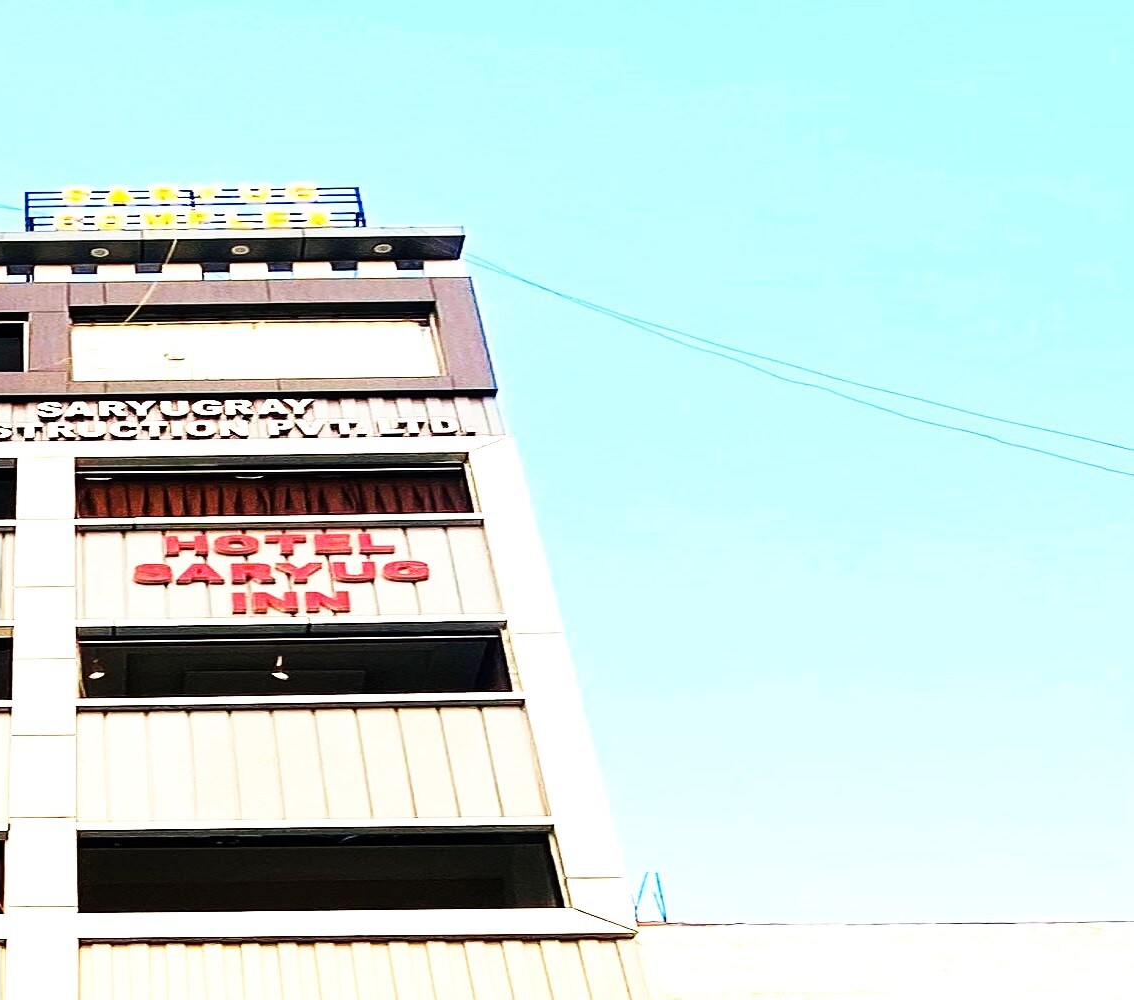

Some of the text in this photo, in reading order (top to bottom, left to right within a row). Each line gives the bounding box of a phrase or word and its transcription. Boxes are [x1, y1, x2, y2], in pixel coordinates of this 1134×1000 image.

[36, 399, 316, 421] SARYUGRAY
[268, 418, 367, 438] PVT.
[377, 416, 478, 437] LTD.
[165, 533, 395, 557] HOTEL
[133, 560, 429, 585] SARYUG
[232, 590, 351, 615] INN
